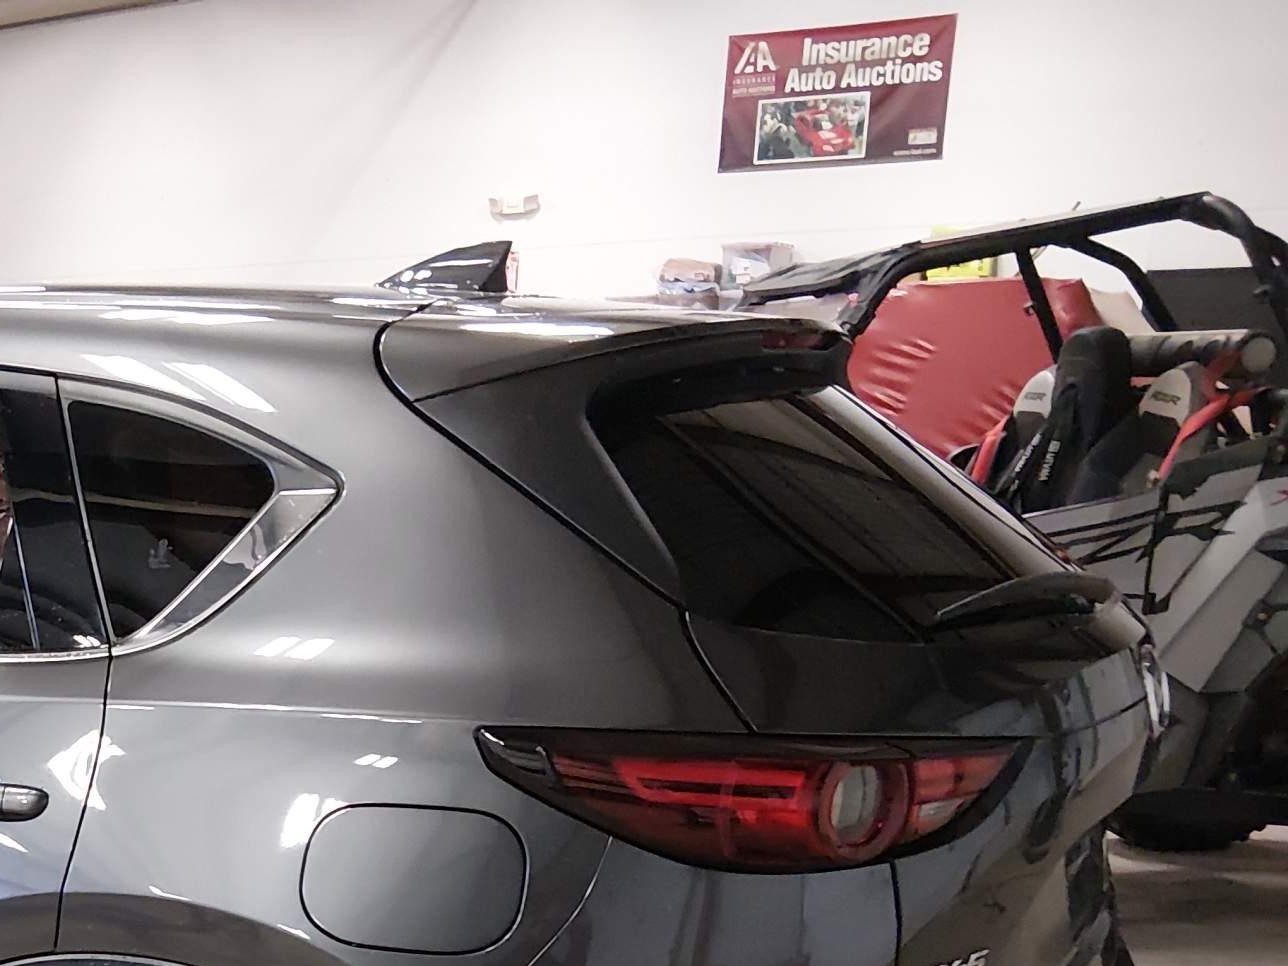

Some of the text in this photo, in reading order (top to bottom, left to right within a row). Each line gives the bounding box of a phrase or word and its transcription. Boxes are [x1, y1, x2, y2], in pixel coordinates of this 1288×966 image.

[803, 33, 929, 65] Insurance
[784, 59, 943, 93] Auto Auctions
